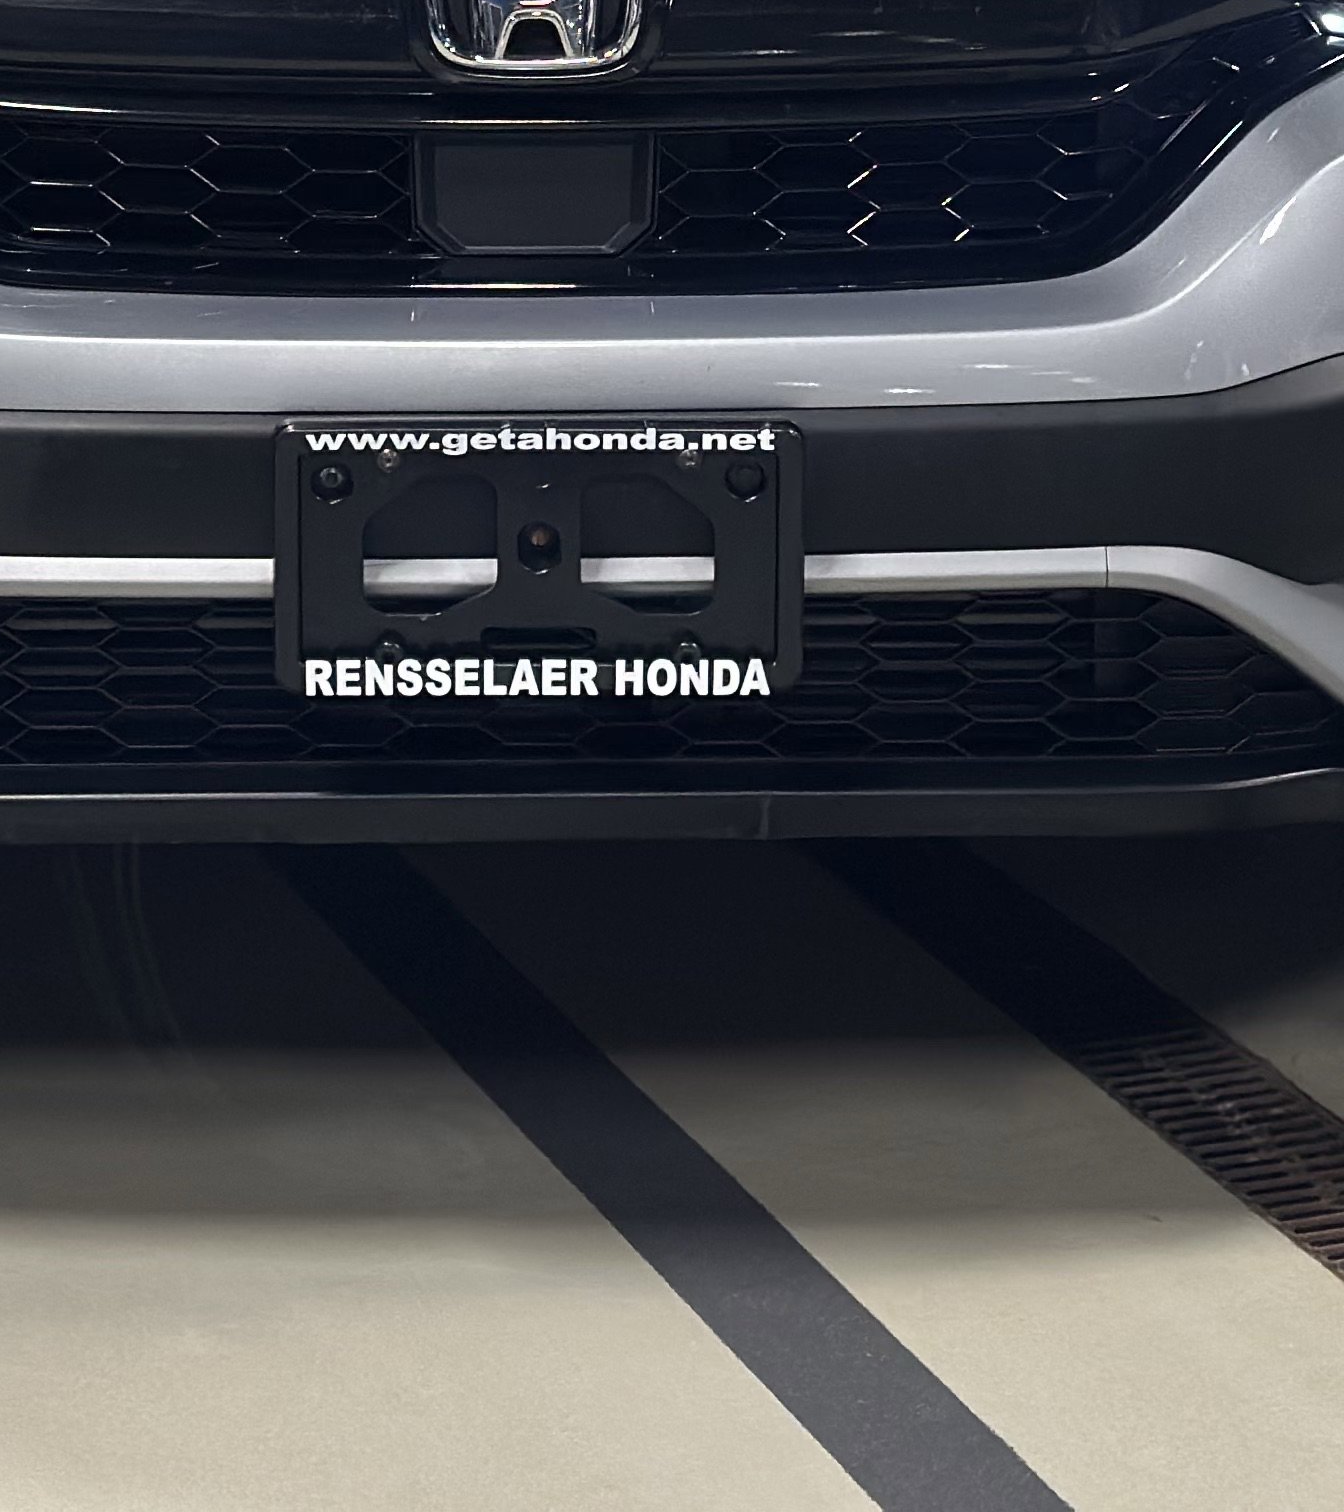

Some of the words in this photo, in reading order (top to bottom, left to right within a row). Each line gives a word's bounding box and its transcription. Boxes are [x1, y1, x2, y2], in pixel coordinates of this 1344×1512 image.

[305, 427, 776, 456] www.getahonda.net
[305, 658, 599, 697] RENSSELAER
[615, 658, 771, 697] HONDA
